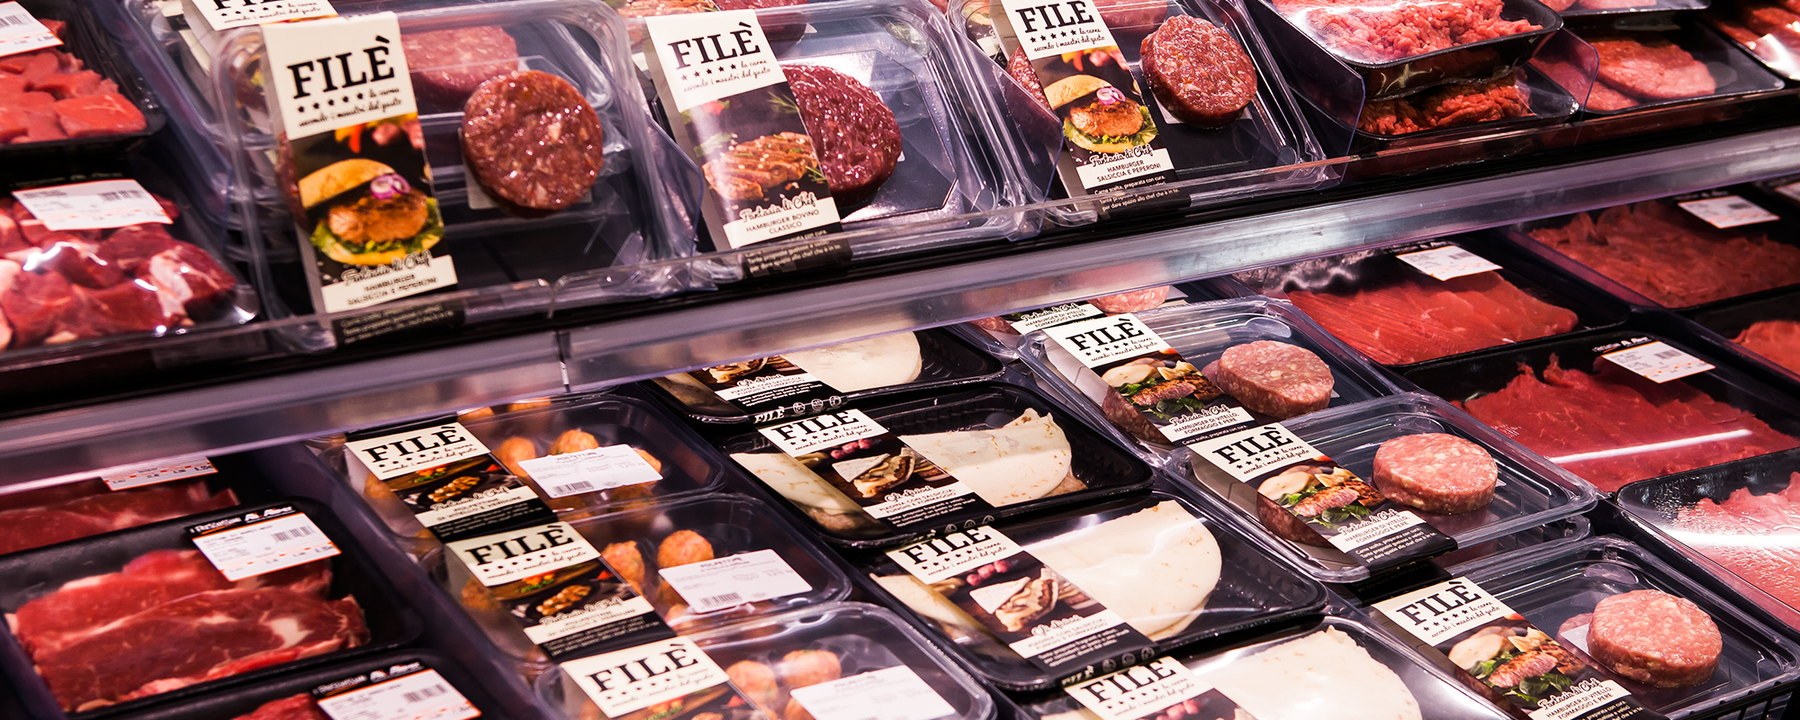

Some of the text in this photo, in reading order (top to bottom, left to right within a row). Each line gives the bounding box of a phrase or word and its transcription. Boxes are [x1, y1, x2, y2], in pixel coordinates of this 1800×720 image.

[670, 22, 759, 67] FILÈ
[289, 36, 393, 98] FILÈ
[1089, 145, 1153, 167] Fantasia di Chef
[1107, 160, 1143, 171] HAMBURGER
[1096, 171, 1126, 182] SALSICCIA
[1132, 163, 1160, 172] PEPERONI
[738, 205, 781, 220] Fantasia
[791, 193, 816, 209] Chef
[746, 209, 819, 230] HAMBURGER BOVINO
[768, 221, 801, 233] CLASSICO
[1066, 318, 1143, 350] FILÈ
[754, 406, 785, 424] FILÈ
[1174, 420, 1208, 432] HAMBURGER
[1184, 422, 1218, 434] FORMAGGIO
[363, 426, 464, 462] FILÈ
[1213, 427, 1292, 463] FILÈ
[1344, 526, 1378, 541] HAMBURGER
[1355, 528, 1390, 542] FORMAGGIO
[466, 525, 572, 564] FILÈ
[1397, 581, 1480, 624] FILÈ
[589, 643, 697, 691] FILÈ
[1546, 699, 1586, 717] HAMBURGER
[1553, 701, 1593, 718] FORMAGGIO
